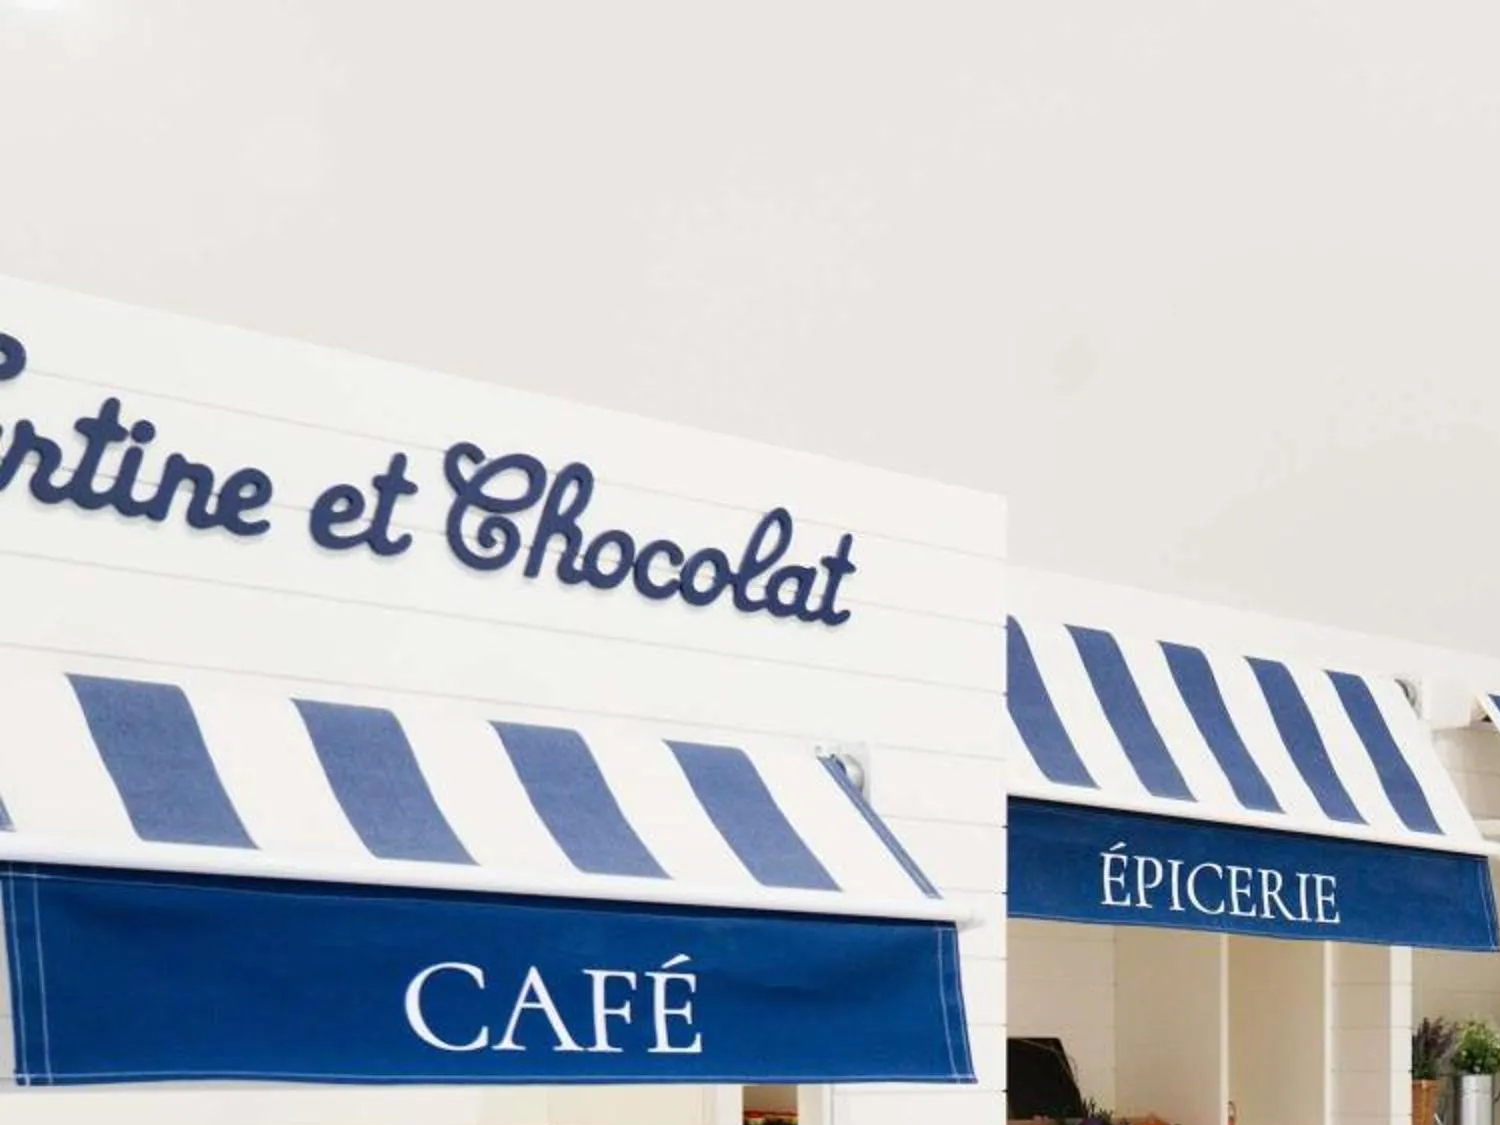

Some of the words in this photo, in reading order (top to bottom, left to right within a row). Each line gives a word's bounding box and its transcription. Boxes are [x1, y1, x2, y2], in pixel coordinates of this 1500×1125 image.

[0, 333, 273, 537] rtine
[309, 452, 418, 557] et
[443, 442, 857, 627] Chocolat
[1101, 841, 1341, 924] ÉPICERIE
[405, 953, 703, 1053] CAFÉ
